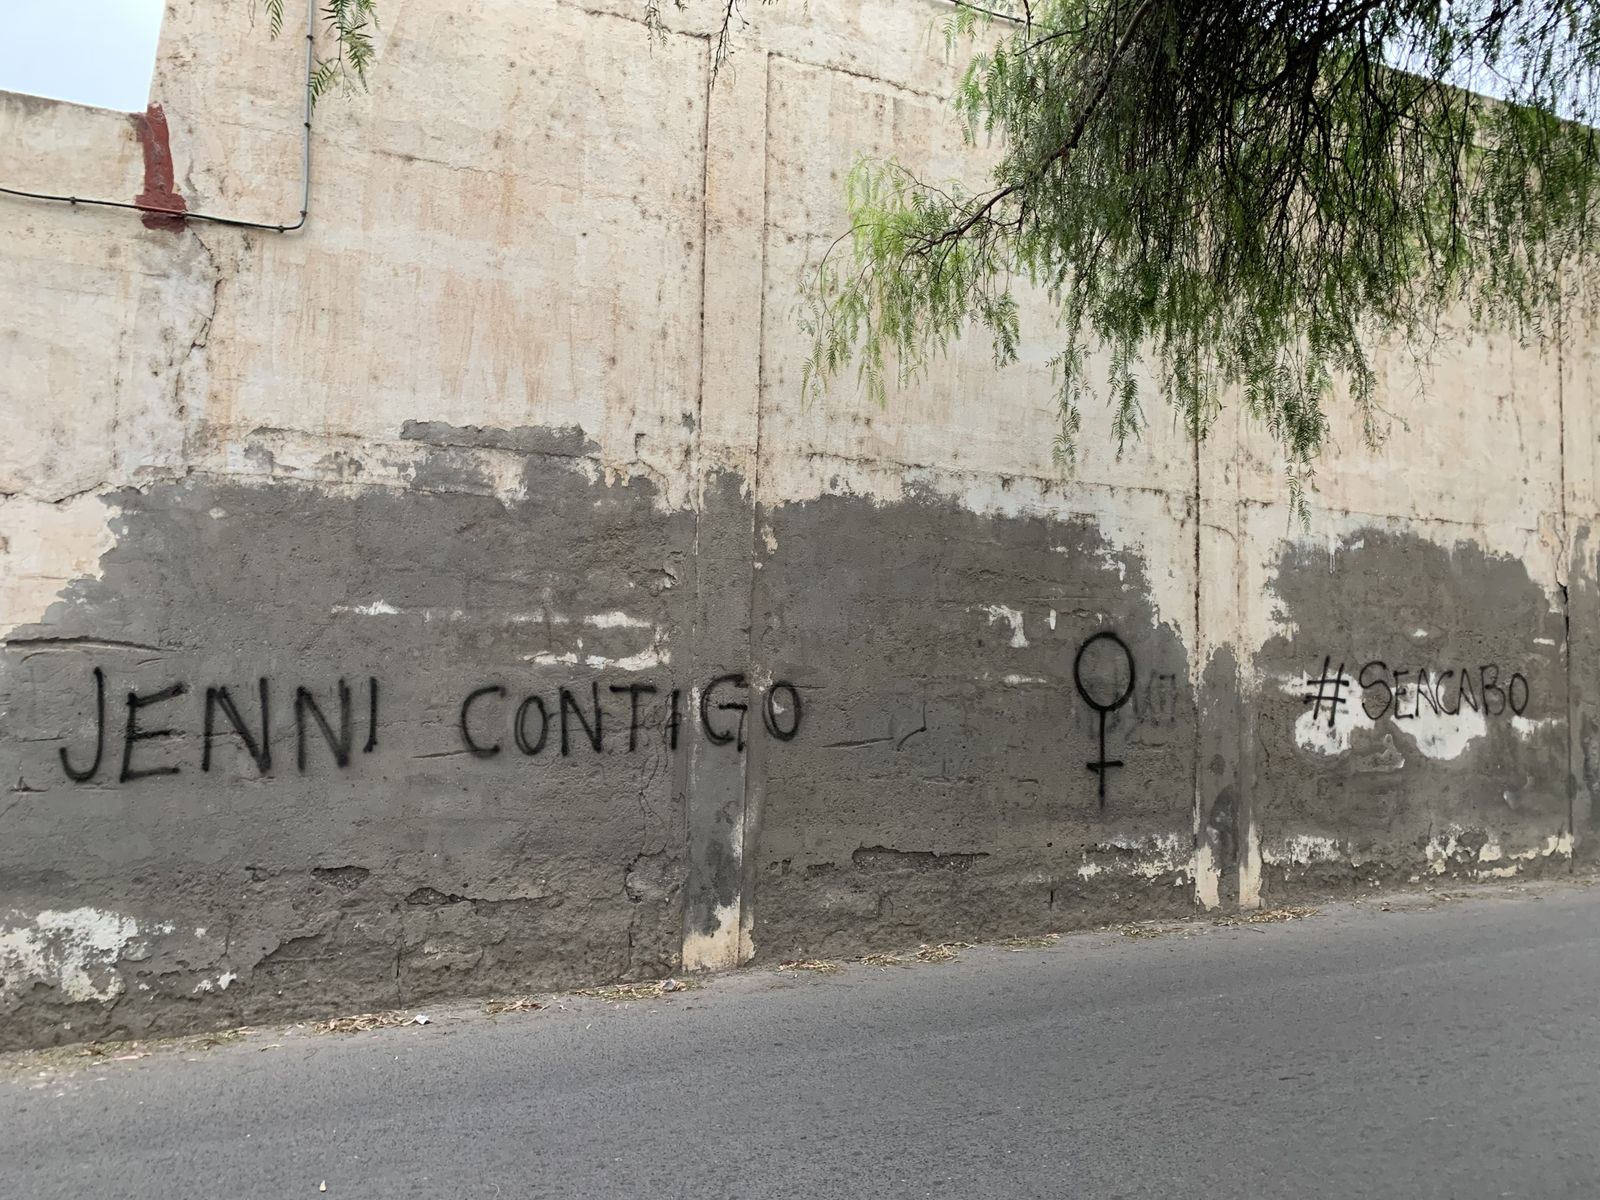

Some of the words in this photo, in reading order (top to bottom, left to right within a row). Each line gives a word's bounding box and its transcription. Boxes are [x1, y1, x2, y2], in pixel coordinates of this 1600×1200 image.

[59, 666, 380, 783] JENNI
[460, 673, 803, 759] CONTIGO
[1303, 655, 1530, 728] #SEACABO
